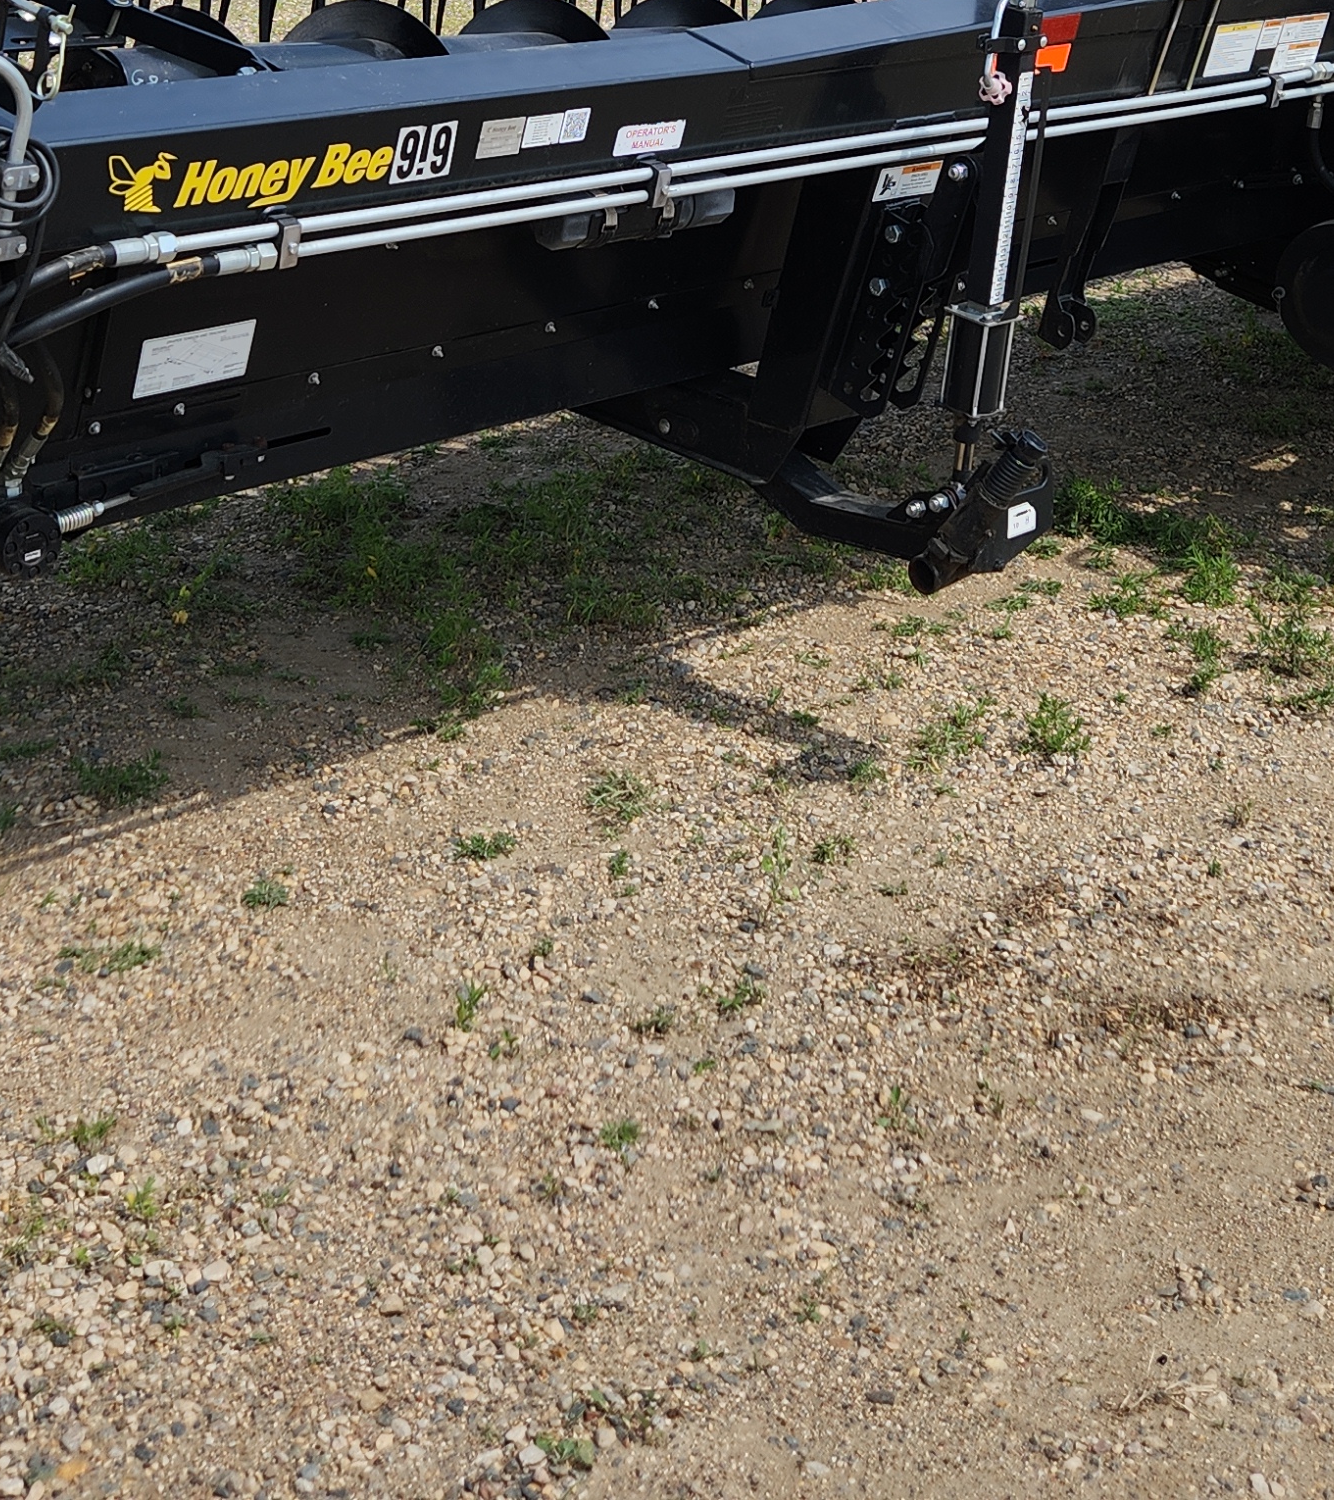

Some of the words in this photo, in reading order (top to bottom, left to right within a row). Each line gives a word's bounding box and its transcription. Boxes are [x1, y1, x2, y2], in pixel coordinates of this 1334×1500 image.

[625, 125, 677, 139] OPERATOR'S
[631, 138, 665, 149] MANUAL
[173, 156, 317, 209] Honey
[310, 143, 394, 189] Bee
